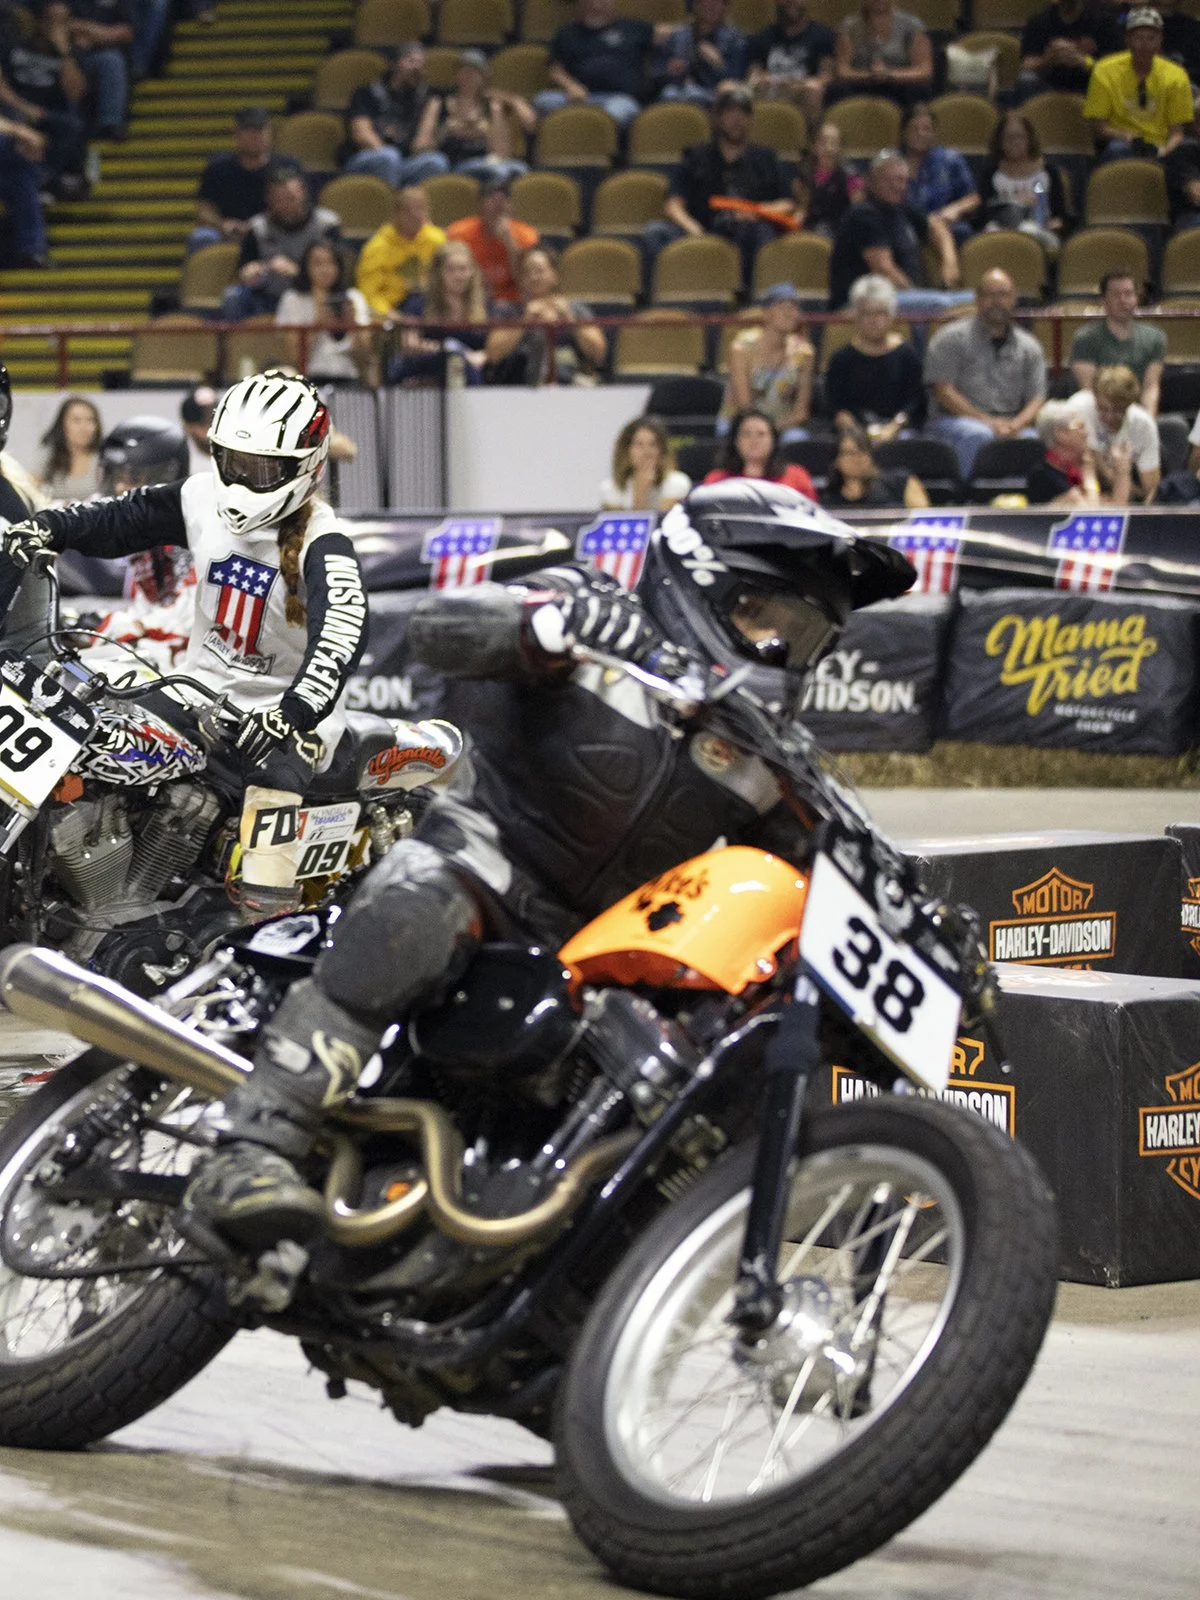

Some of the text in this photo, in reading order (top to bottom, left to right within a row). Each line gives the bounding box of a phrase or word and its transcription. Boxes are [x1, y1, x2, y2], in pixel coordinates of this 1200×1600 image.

[985, 613, 1147, 672] Mama
[1000, 637, 1157, 716] Tried
[296, 840, 349, 877] 09
[1022, 877, 1084, 915] MOTOR
[995, 919, 1112, 960] HARLEY-DAVIDSON
[832, 917, 925, 1033] 38
